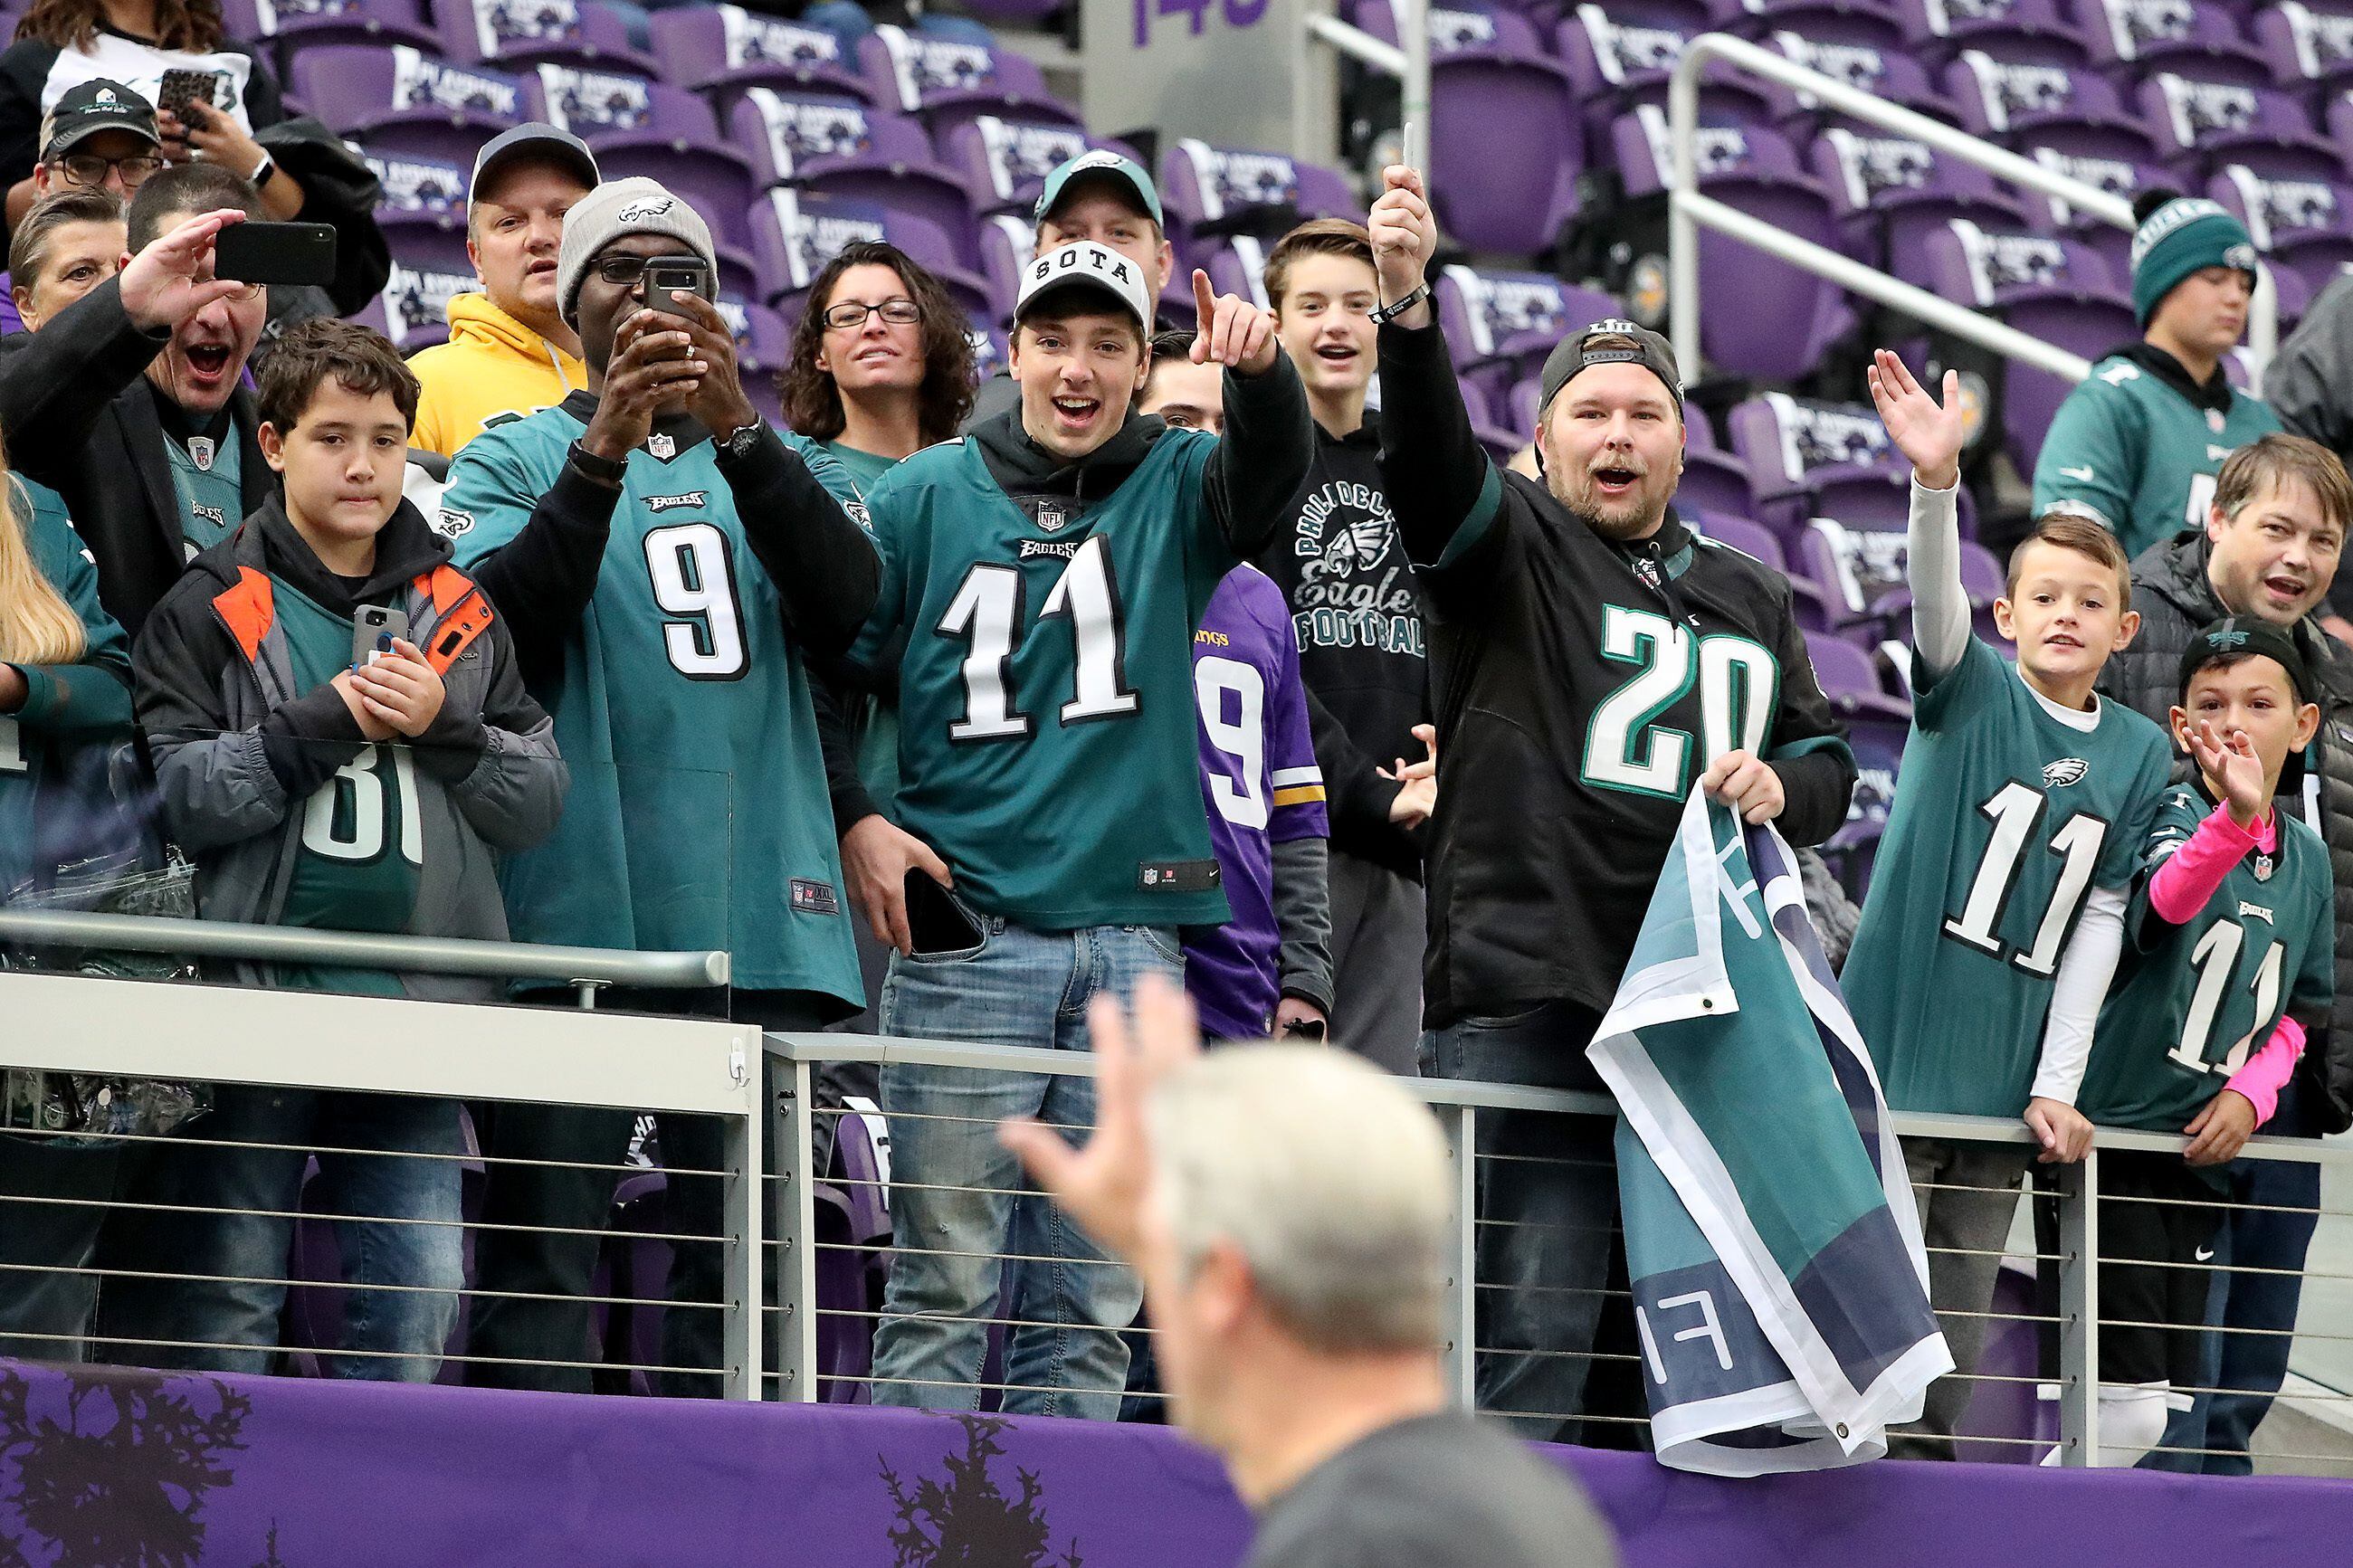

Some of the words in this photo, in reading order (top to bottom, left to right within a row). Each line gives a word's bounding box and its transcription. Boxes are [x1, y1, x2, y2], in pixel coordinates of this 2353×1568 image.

[1035, 249, 1129, 285] SOTA
[1588, 318, 1634, 333] LII
[653, 443, 672, 455] NFL
[645, 491, 707, 512] EAGLES
[1020, 539, 1078, 558] EAGLES
[1043, 513, 1061, 525] NFL
[643, 523, 748, 679] 9
[936, 536, 1138, 740] 11
[1195, 656, 1267, 831] 9
[1580, 603, 1781, 803] 20
[1944, 780, 2109, 977] 11
[2167, 918, 2284, 1077] 11
